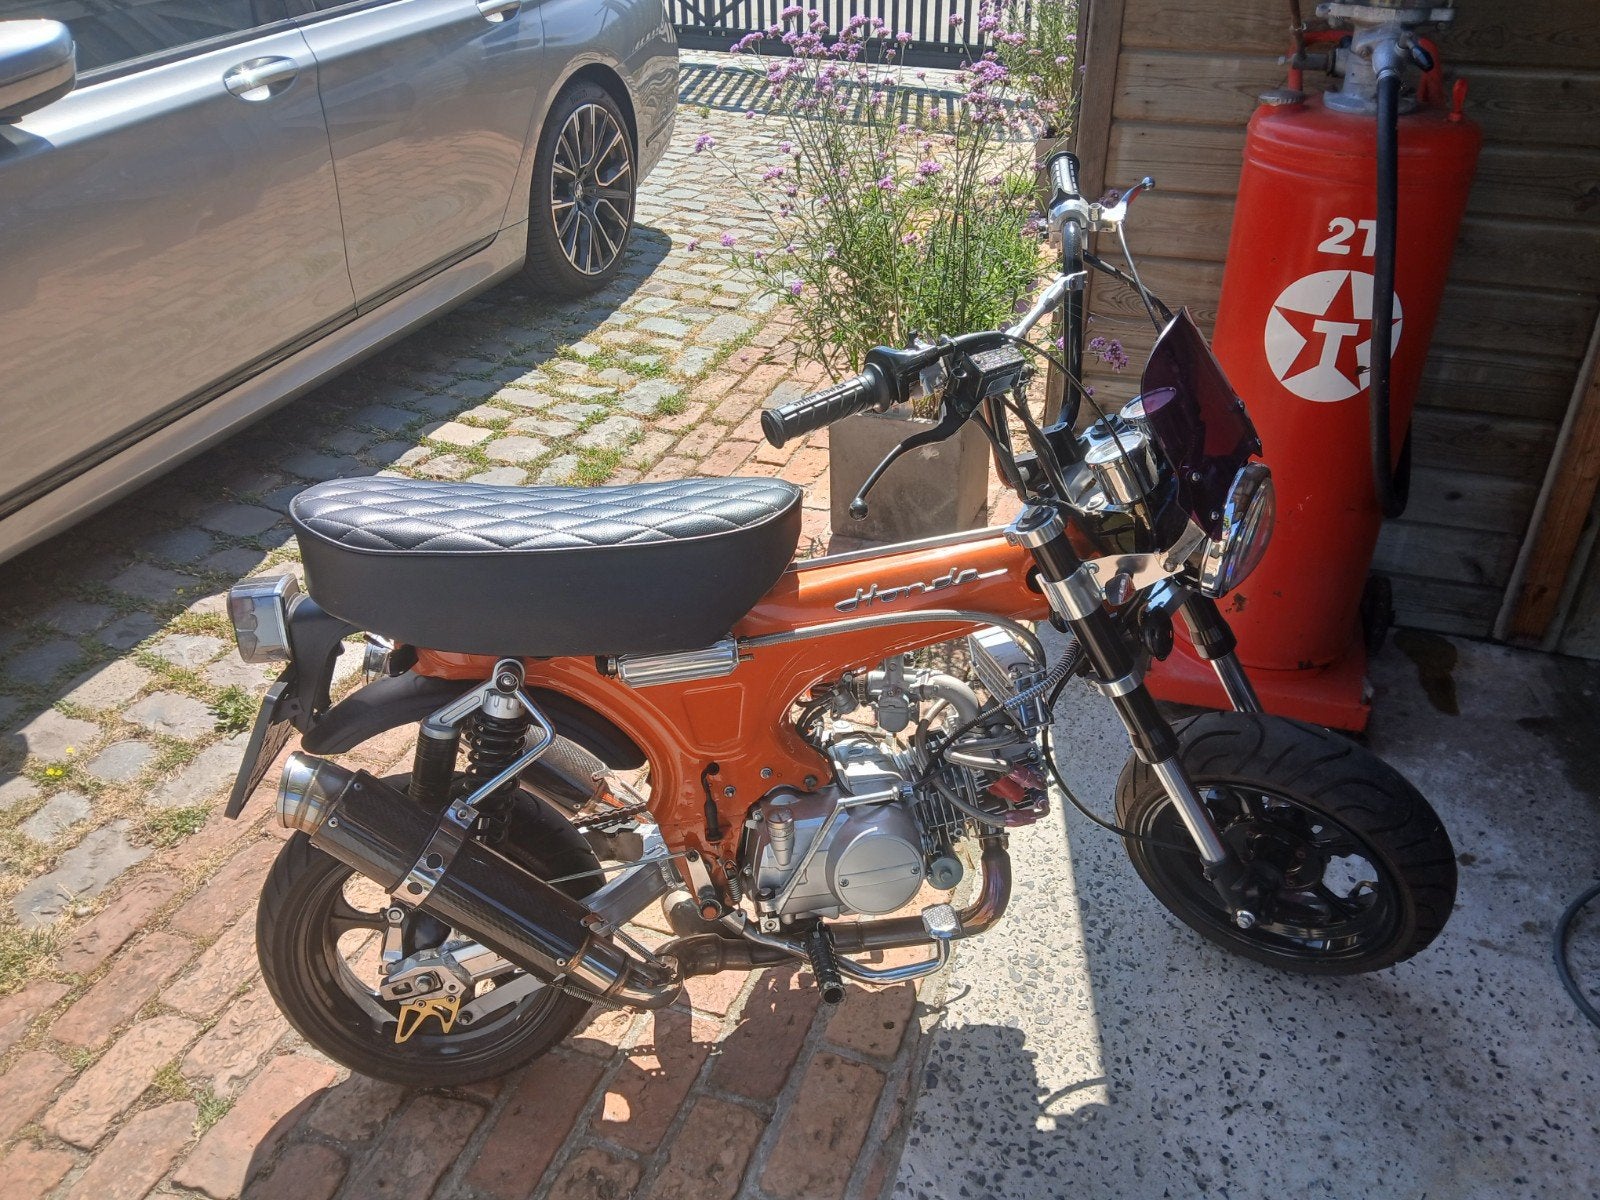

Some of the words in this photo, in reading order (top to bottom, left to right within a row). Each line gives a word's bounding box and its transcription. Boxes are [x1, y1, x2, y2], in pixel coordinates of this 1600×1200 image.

[1317, 216, 1377, 257] 2T
[1313, 319, 1360, 369] T
[834, 567, 1008, 612] Honda
